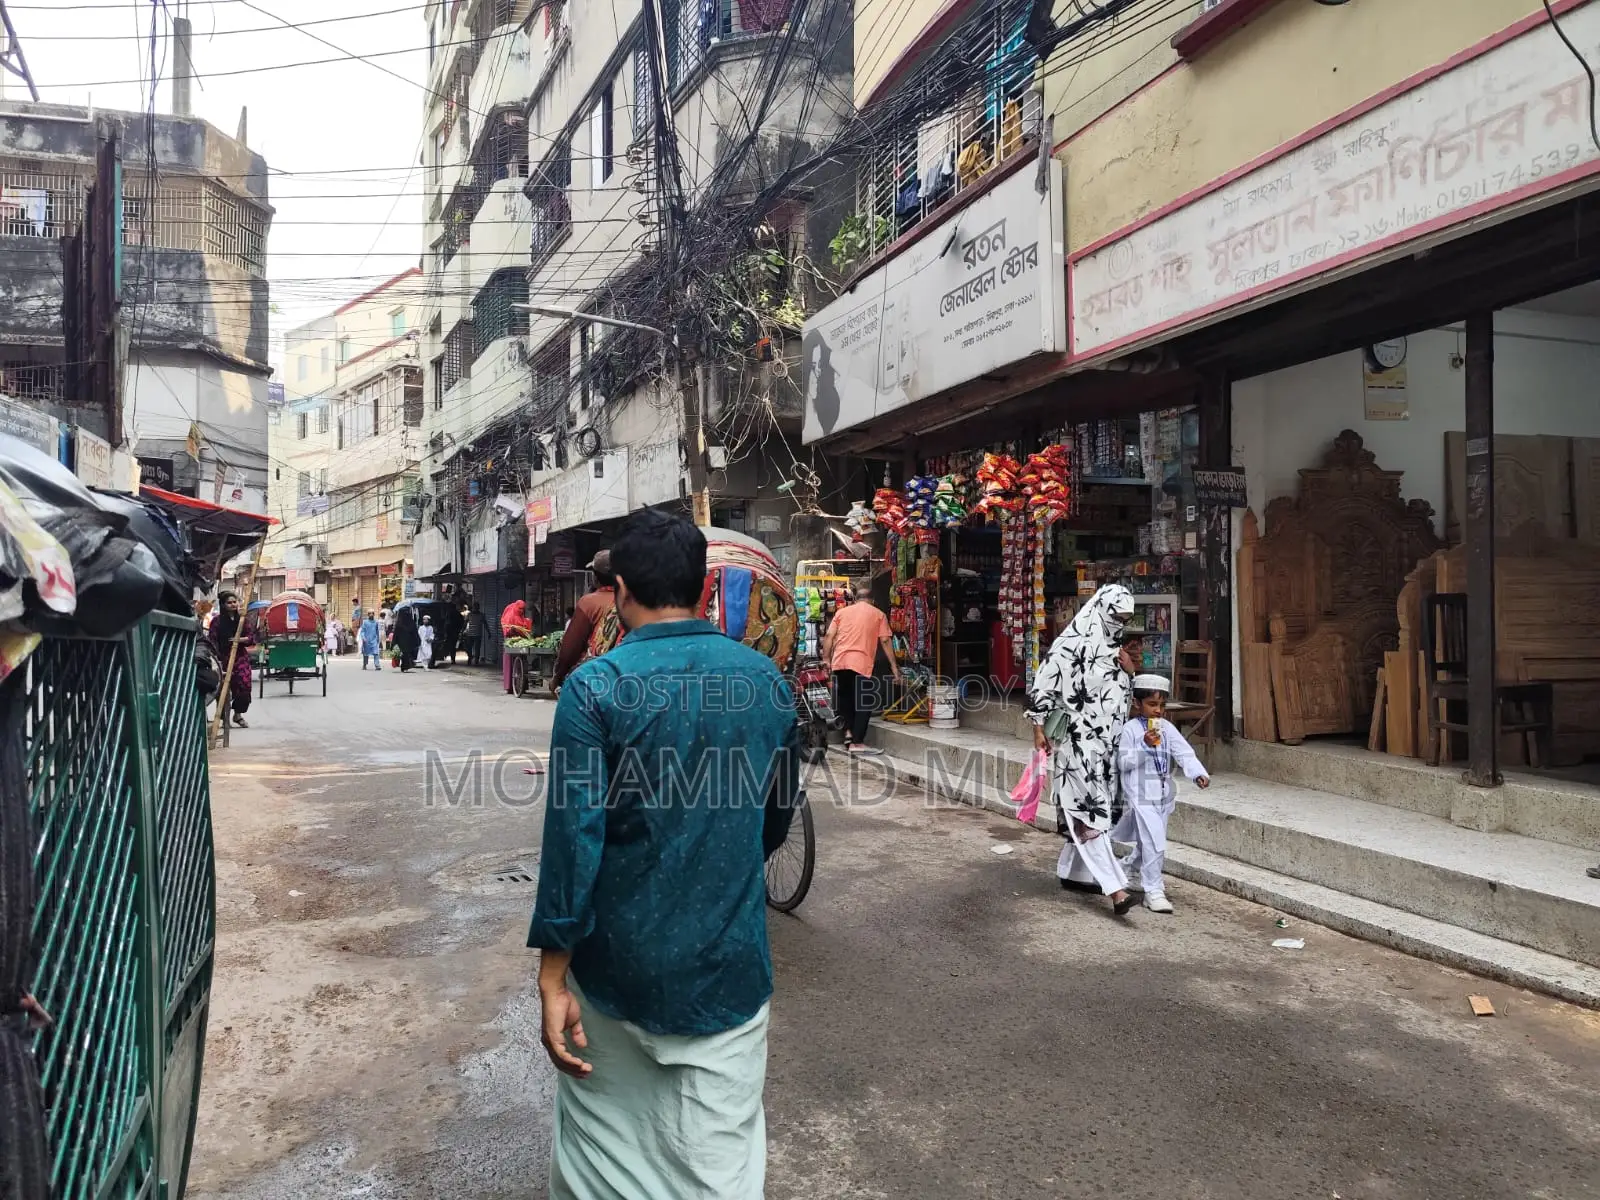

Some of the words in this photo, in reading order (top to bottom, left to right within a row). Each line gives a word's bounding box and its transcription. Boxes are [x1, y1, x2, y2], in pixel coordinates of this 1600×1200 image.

[962, 218, 1006, 270] রতন
[940, 267, 996, 317] জেনারেল
[156, 465, 170, 484] Gym
